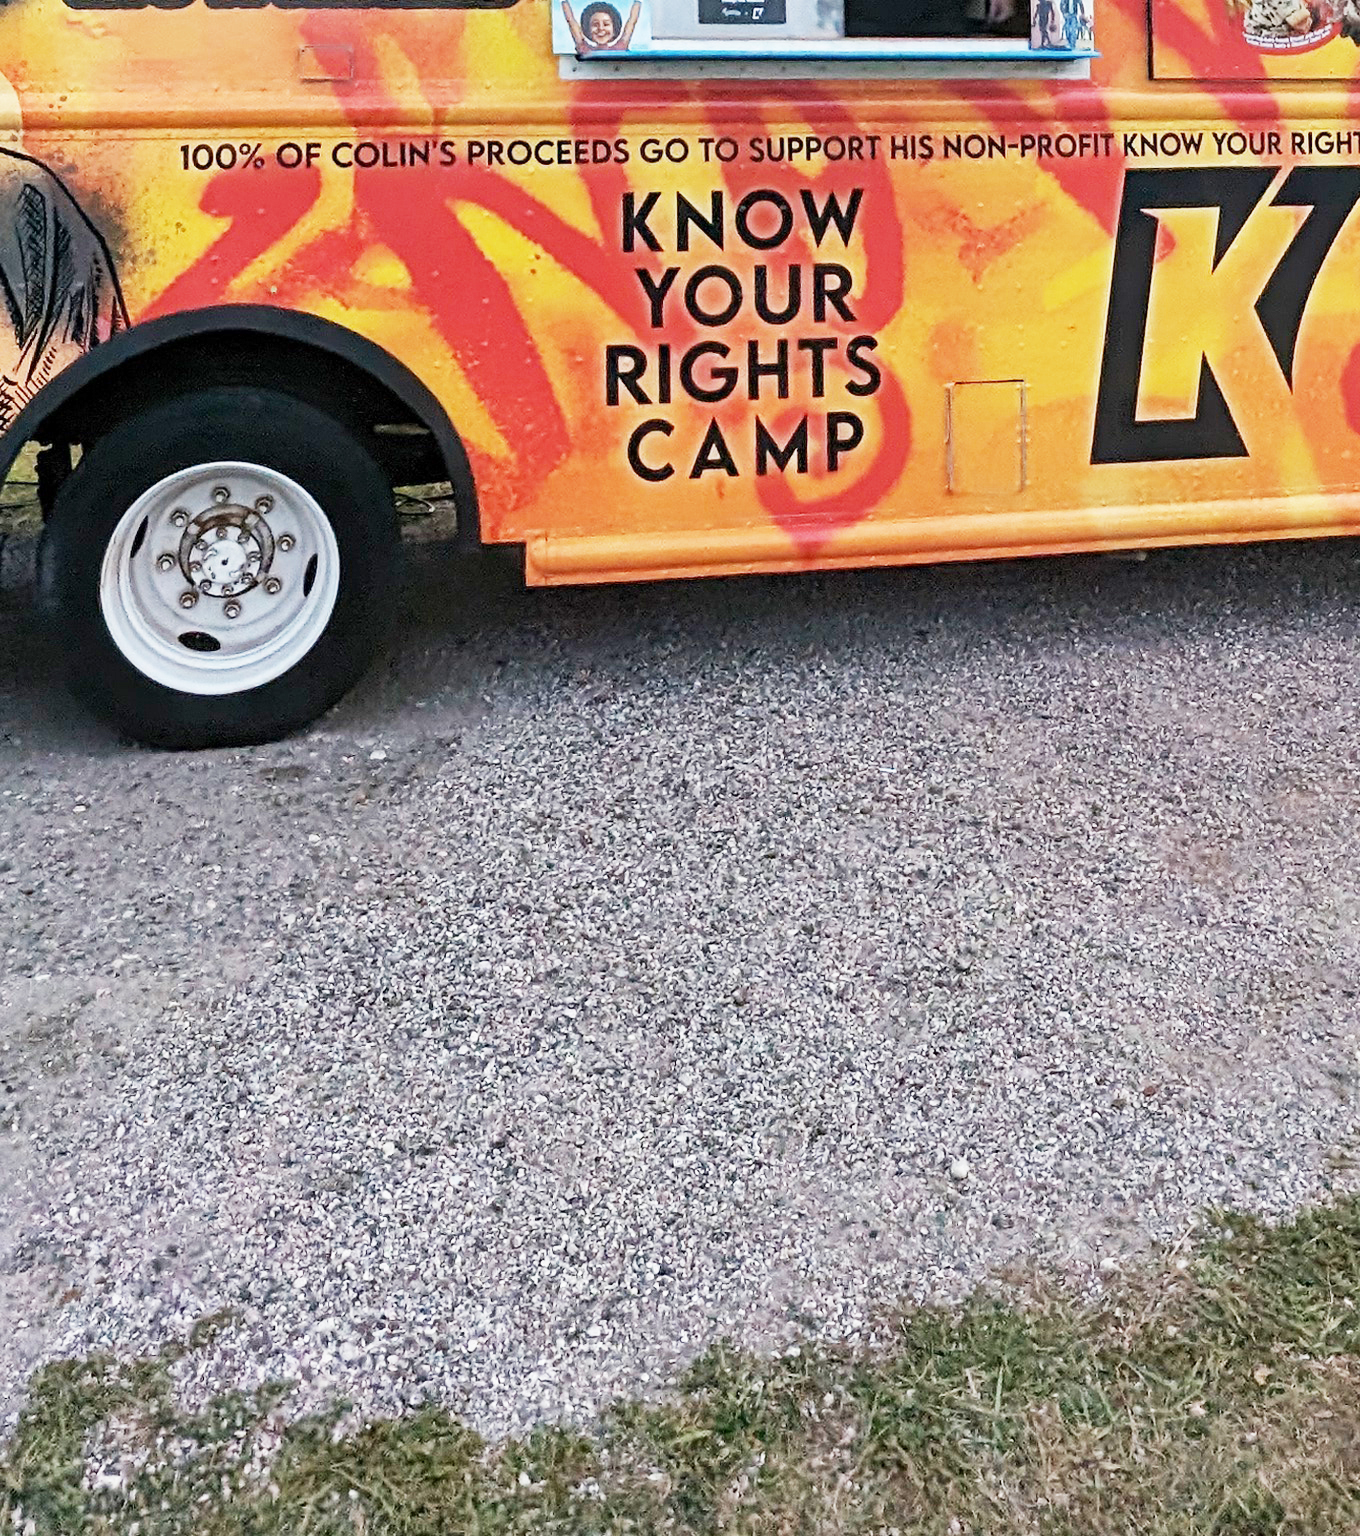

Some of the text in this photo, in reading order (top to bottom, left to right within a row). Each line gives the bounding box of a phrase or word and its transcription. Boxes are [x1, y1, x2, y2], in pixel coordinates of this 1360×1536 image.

[180, 143, 265, 170] 100%
[276, 142, 322, 168] OF
[332, 139, 456, 168] COLIN'S
[467, 138, 630, 166] PROCEEDS
[639, 137, 689, 163] GO
[698, 137, 739, 162] TO
[749, 135, 881, 162] SUPPORT
[890, 134, 935, 160] HIS
[943, 132, 1115, 159] NON-PROFIT
[1123, 132, 1203, 157] KNOW
[1211, 131, 1282, 156] YOUR
[621, 188, 864, 253] KNOW
[635, 262, 858, 329] YOUR
[605, 335, 881, 407] RIGHTS
[627, 410, 865, 483] CAMP
